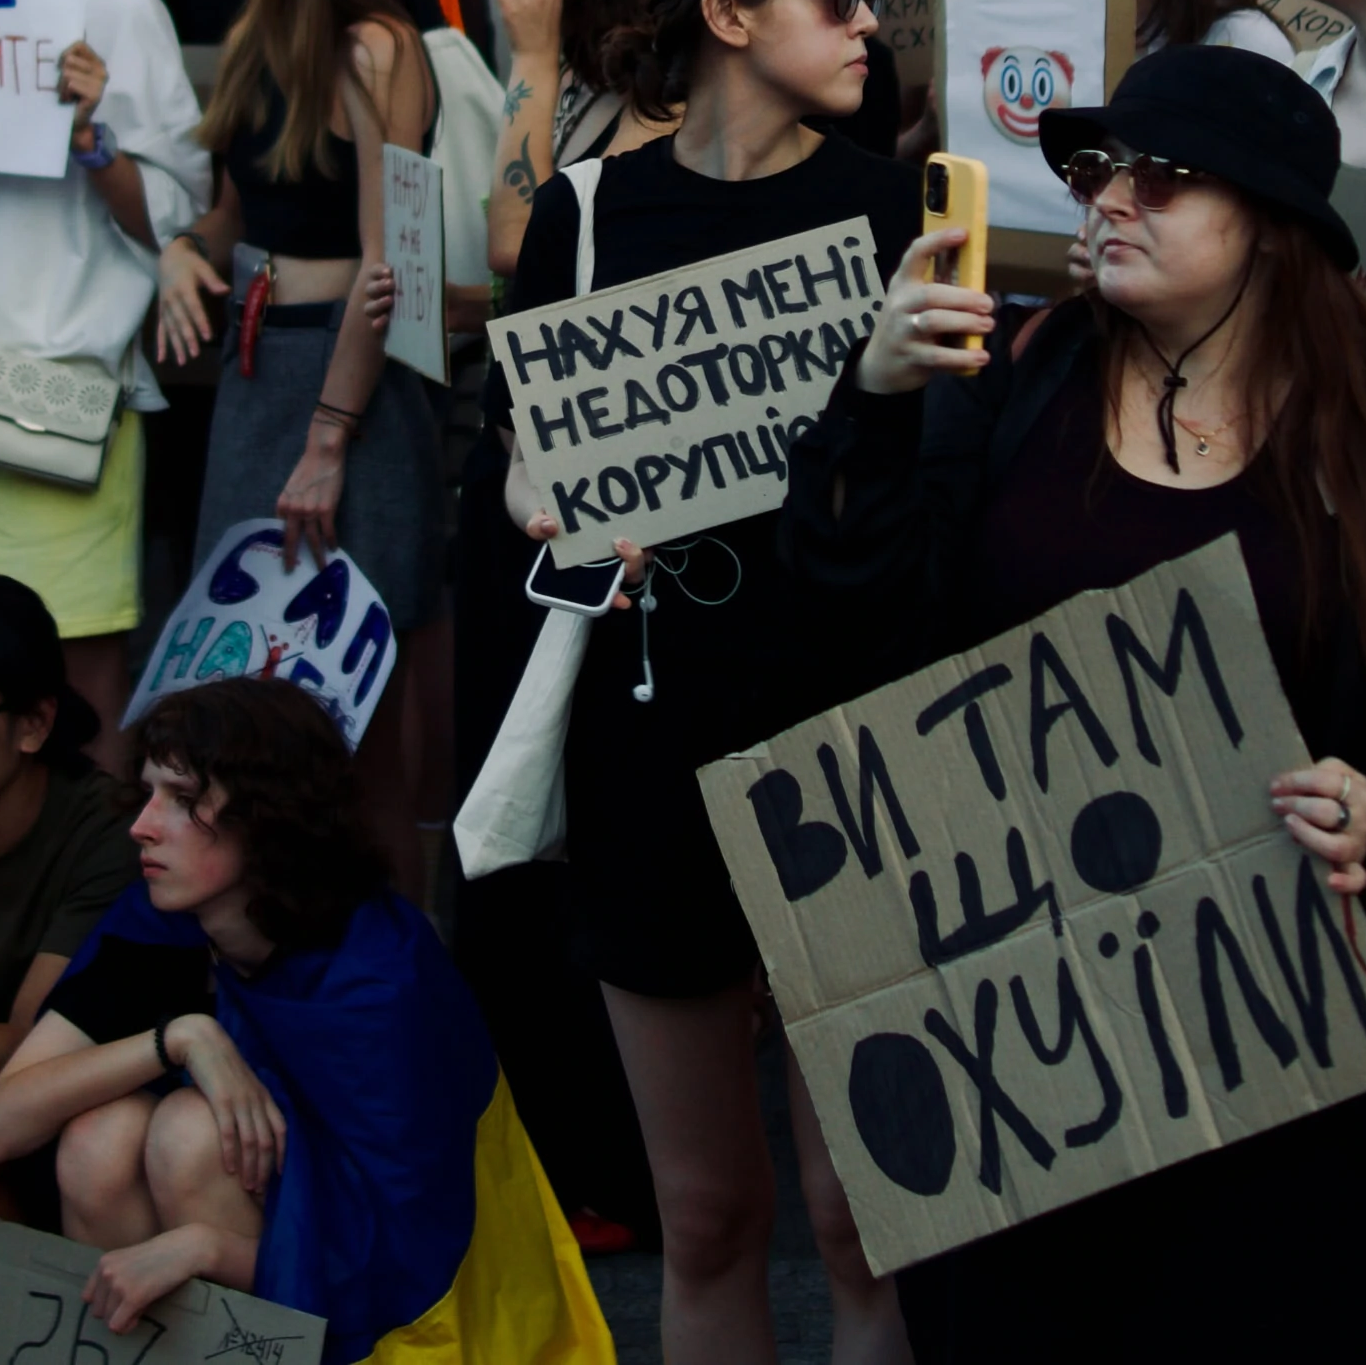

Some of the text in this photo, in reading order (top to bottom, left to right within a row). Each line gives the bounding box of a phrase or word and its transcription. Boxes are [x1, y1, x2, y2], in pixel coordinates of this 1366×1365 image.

[506, 236, 872, 386] НАХУЯ МЕНІ
[529, 300, 883, 452] НЕДОТОРКА
[746, 587, 1247, 903] ВИ ТАМ
[909, 788, 1165, 967] ЩО
